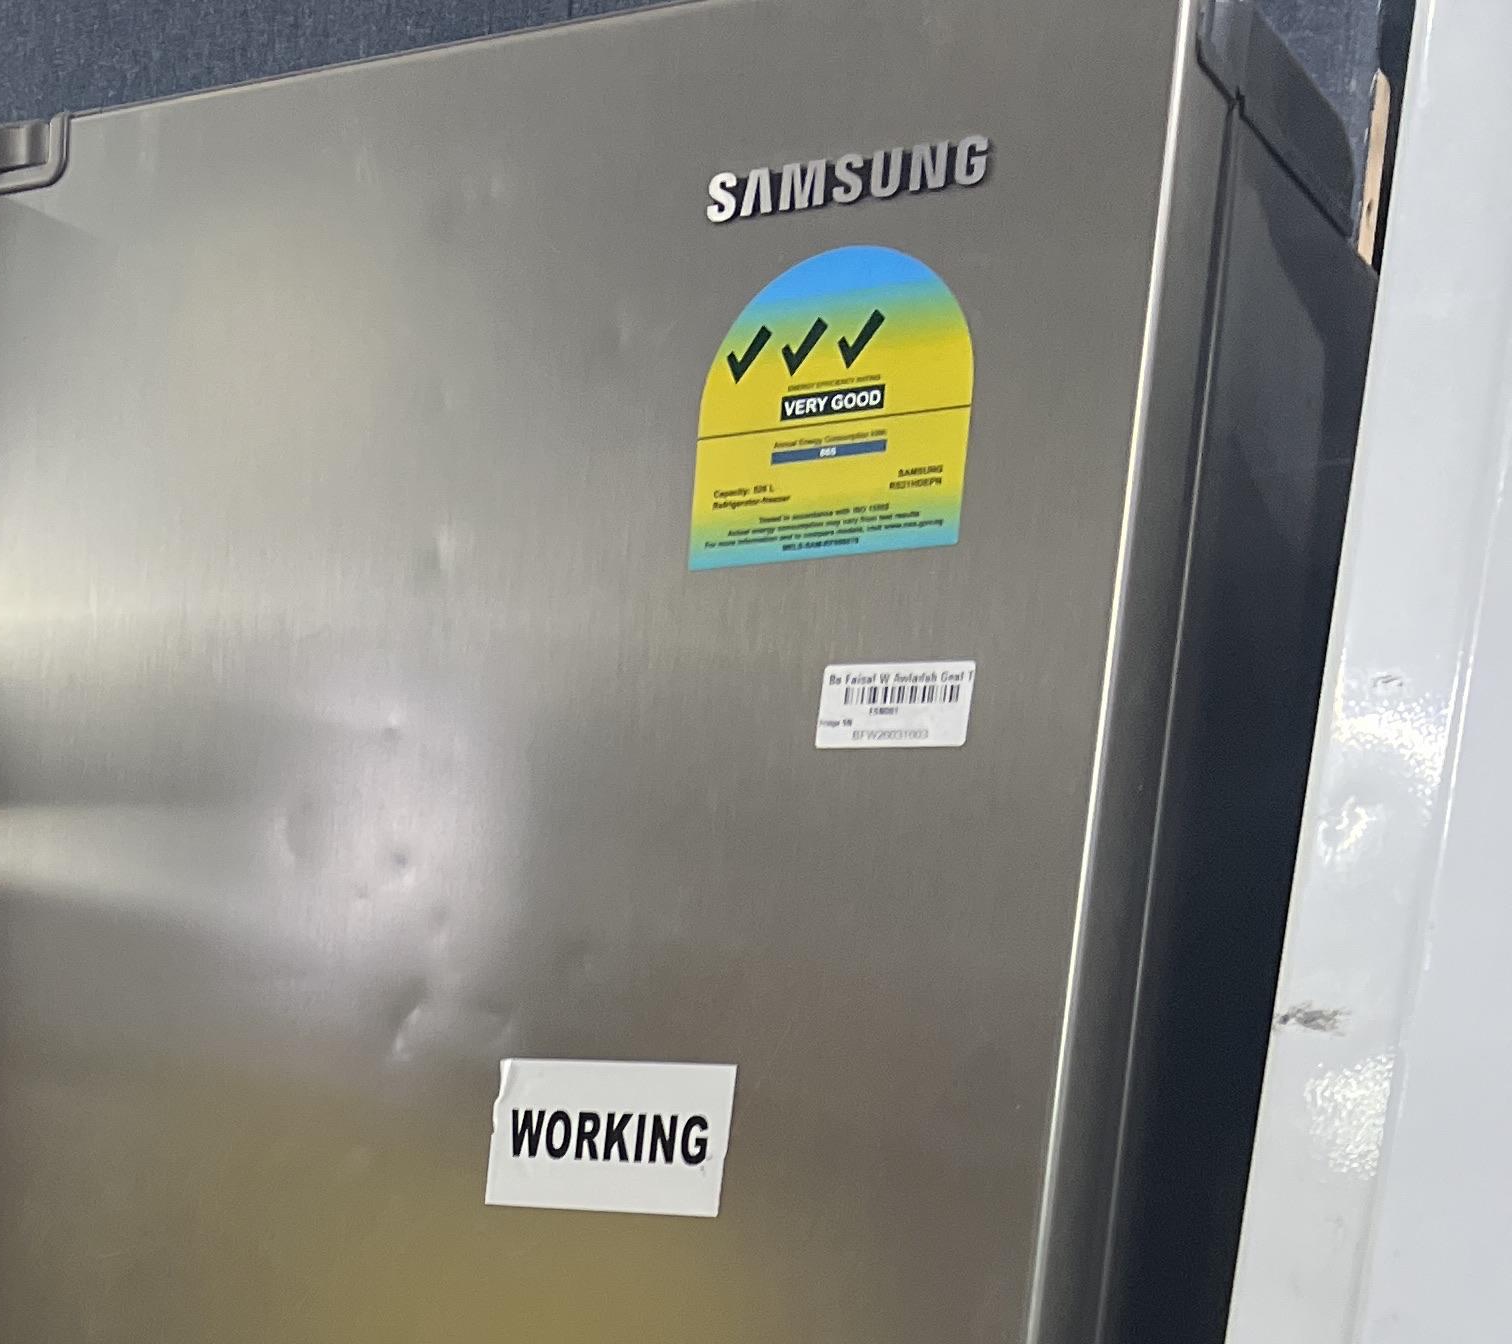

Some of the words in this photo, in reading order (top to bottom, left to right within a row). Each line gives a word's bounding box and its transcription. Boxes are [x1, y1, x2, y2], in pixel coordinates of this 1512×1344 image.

[706, 134, 989, 224] SAMSUNG
[784, 396, 829, 417] VERY
[830, 389, 882, 411] GOOD
[512, 1109, 708, 1165] WORKING
